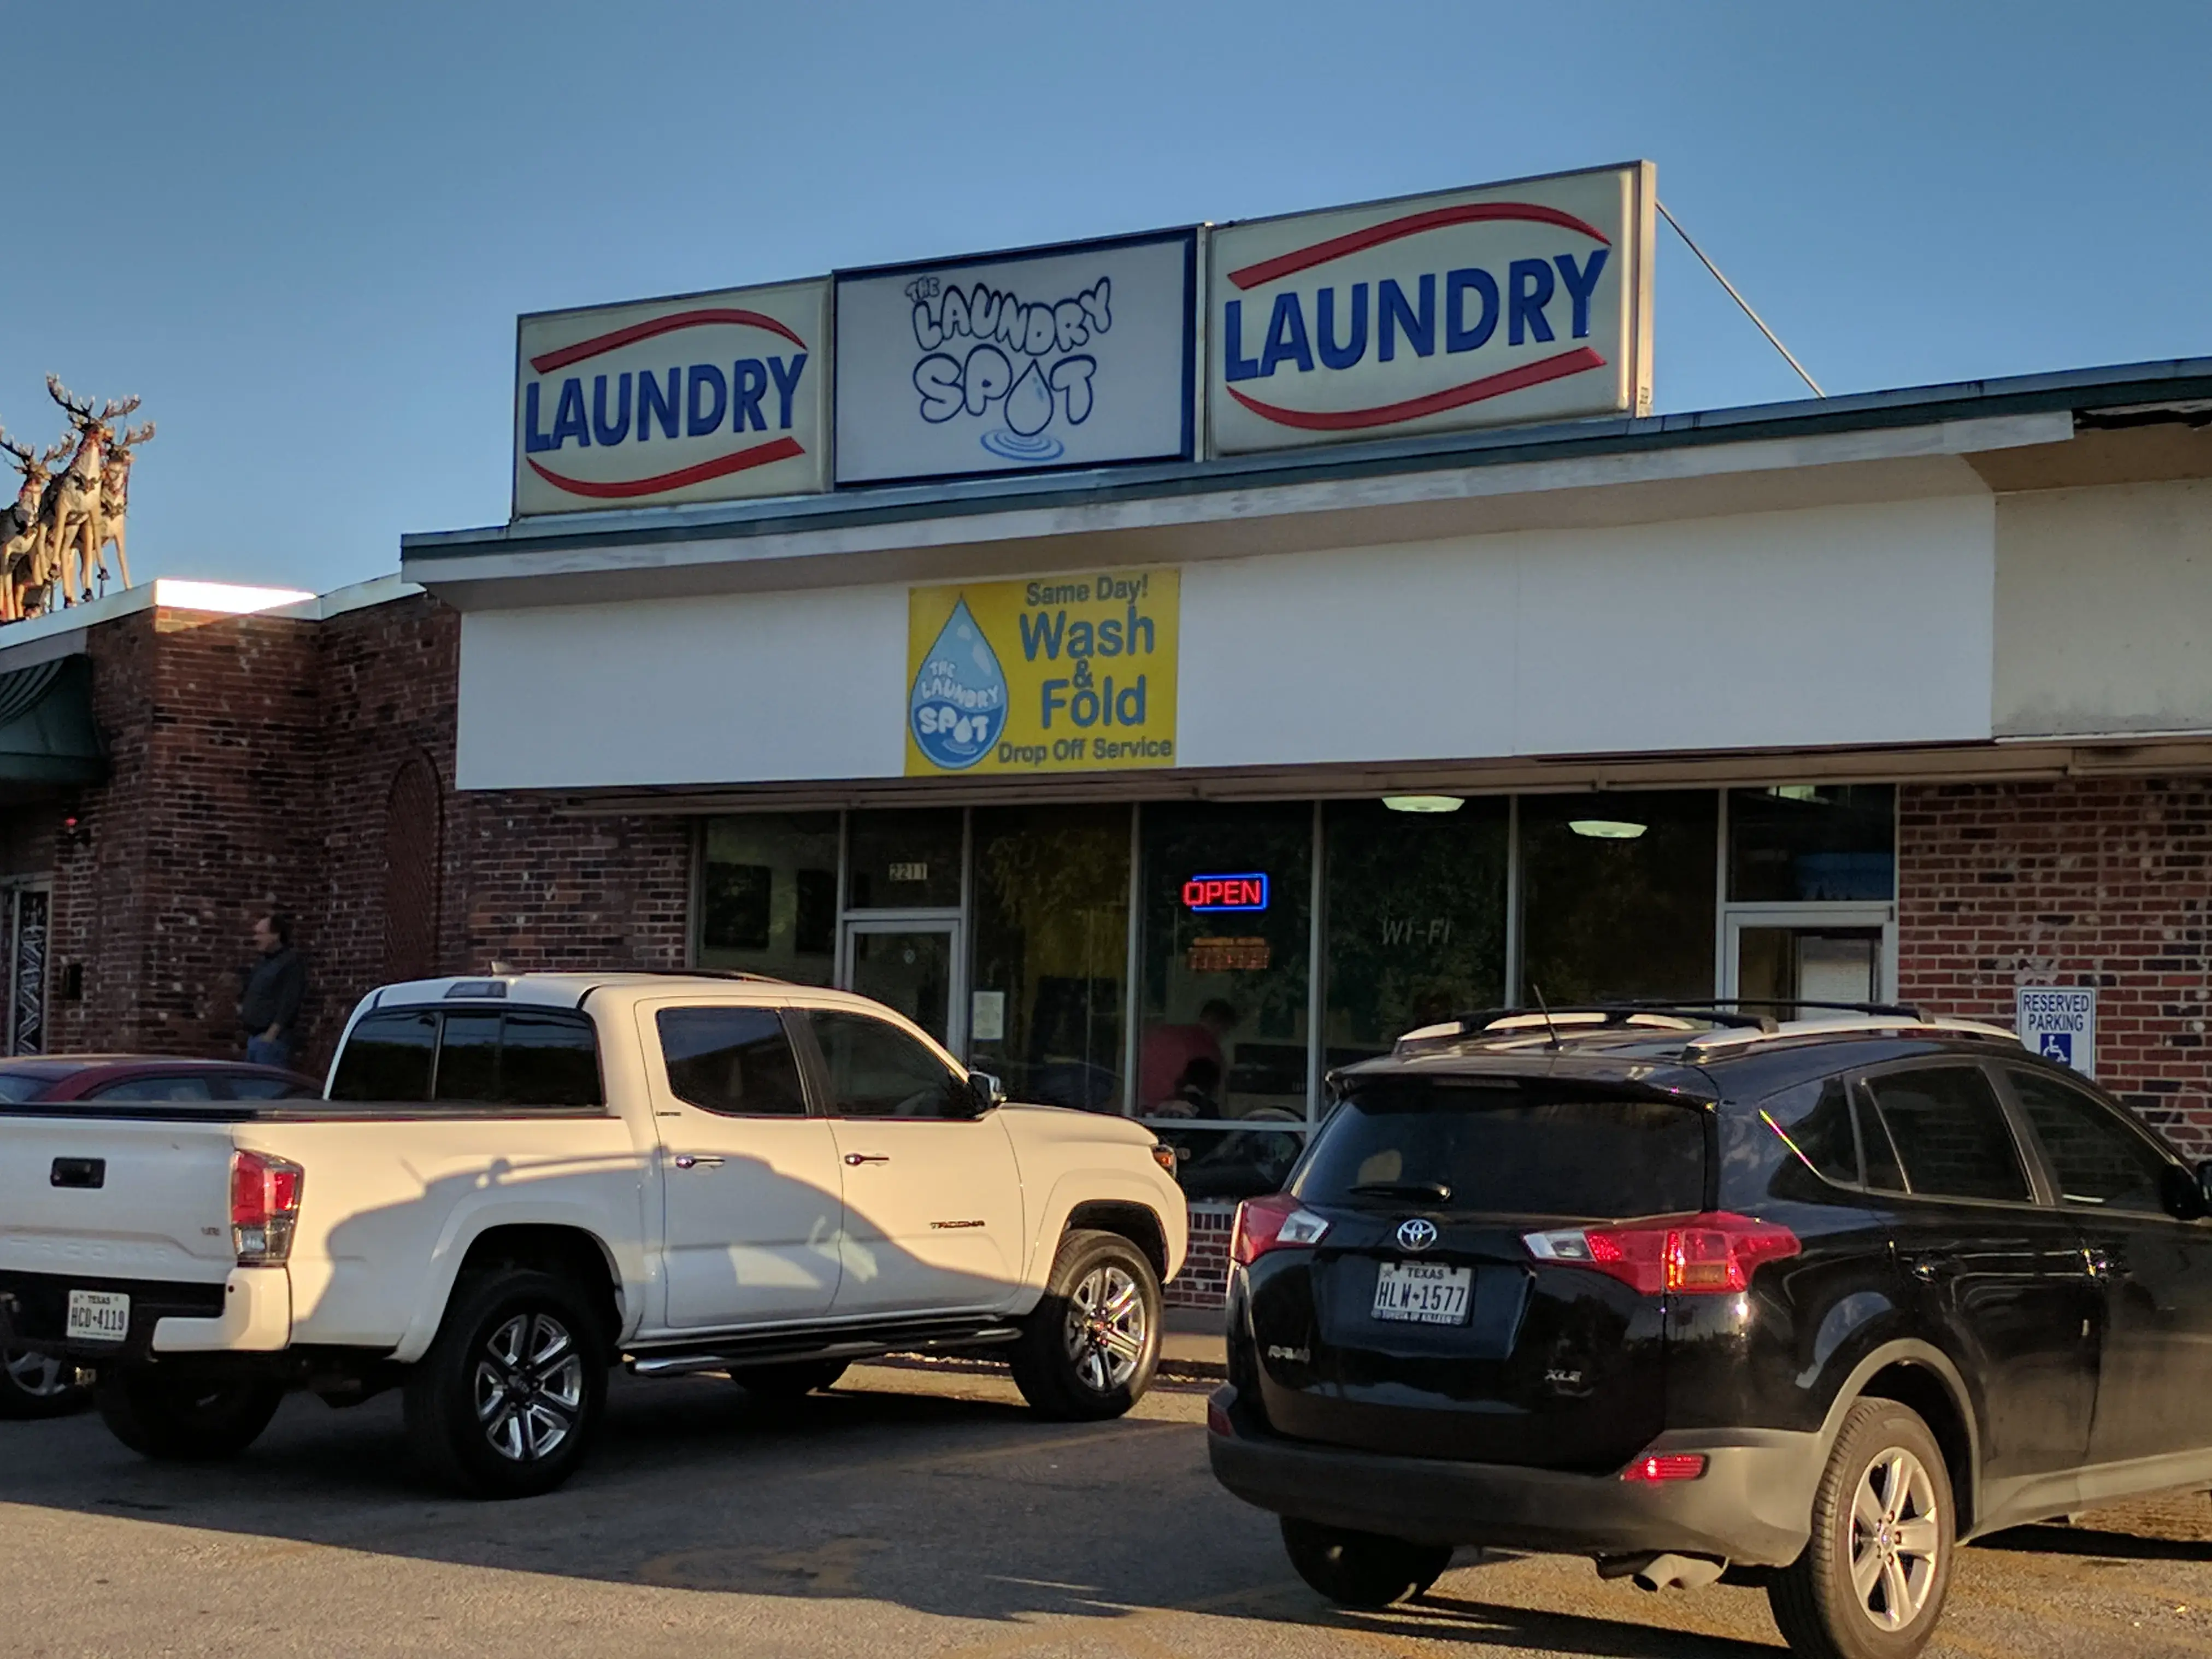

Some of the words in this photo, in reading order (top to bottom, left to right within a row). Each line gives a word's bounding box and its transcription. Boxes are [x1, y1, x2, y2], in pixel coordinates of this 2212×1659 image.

[904, 276, 940, 302] THE
[913, 276, 1111, 356] LAUNDRY
[1225, 247, 1611, 382] LAUNDRY
[525, 354, 808, 453] LAUNDRY
[913, 343, 1097, 437] SPOT
[1026, 583, 1090, 607] Same
[1096, 573, 1148, 604] Day!
[1020, 605, 1154, 662] Wash
[929, 661, 956, 678] THE
[1073, 658, 1093, 689] &
[921, 678, 998, 708] LAUNDRY
[1042, 674, 1146, 730] Fold
[998, 741, 1047, 766] Drop
[1052, 738, 1087, 762] Off
[1093, 736, 1172, 760] Service
[1183, 880, 1261, 907] OPEN
[2023, 994, 2090, 1013] RESERVED
[2028, 1013, 2084, 1032] PARKING
[1407, 1267, 1445, 1280] TEXAS
[87, 1295, 111, 1304] TEXAS
